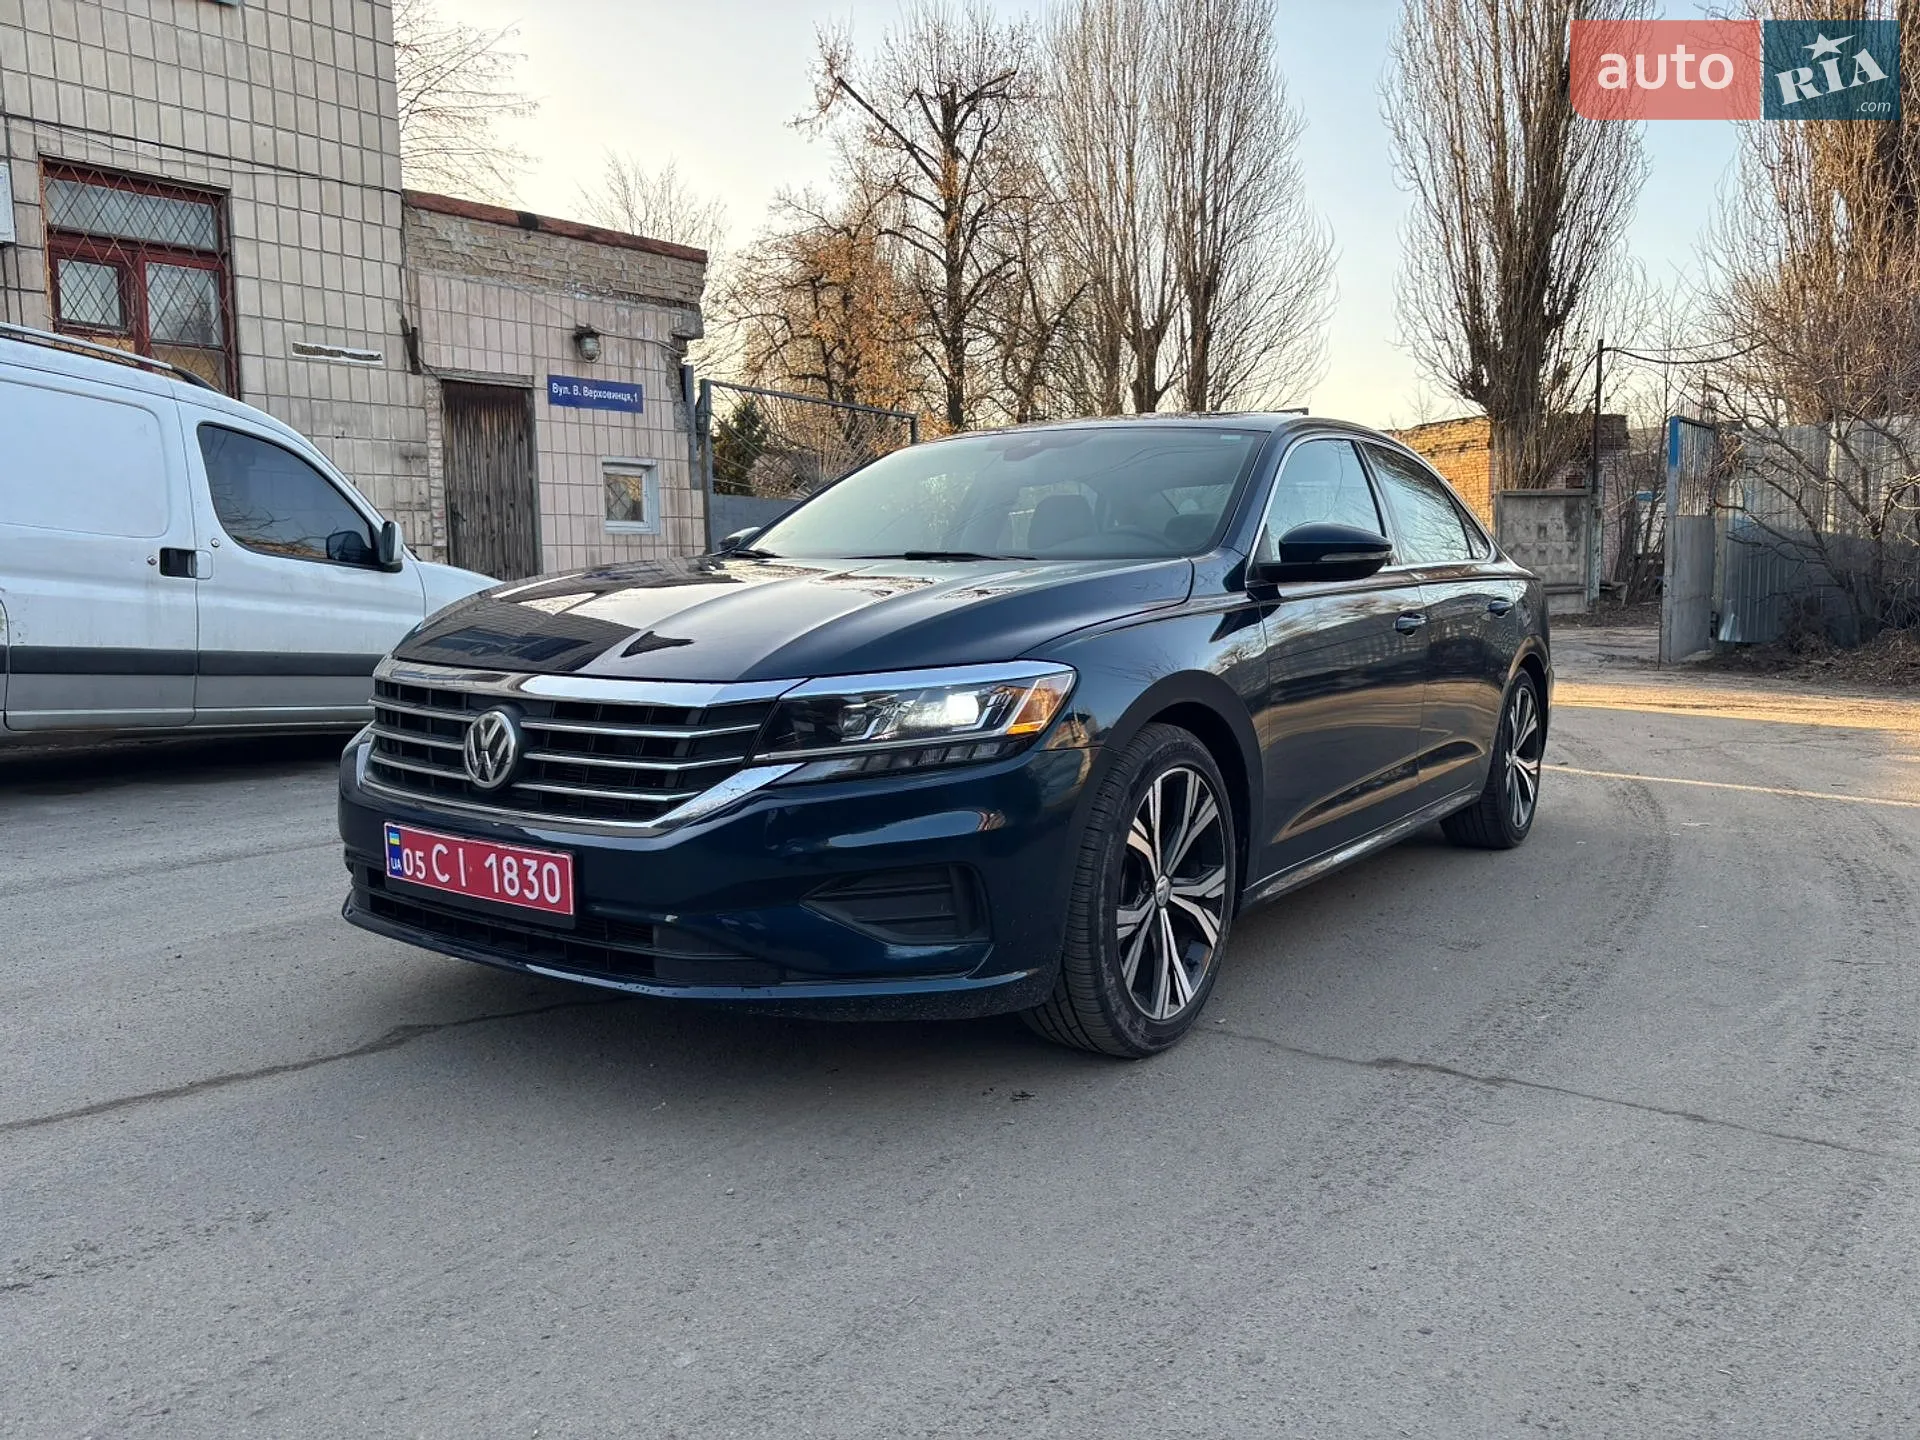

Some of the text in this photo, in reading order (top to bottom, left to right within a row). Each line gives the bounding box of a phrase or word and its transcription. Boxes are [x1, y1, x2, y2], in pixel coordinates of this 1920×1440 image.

[552, 382, 571, 396] Вул.
[390, 857, 402, 871] UA
[484, 853, 561, 904] 1830
